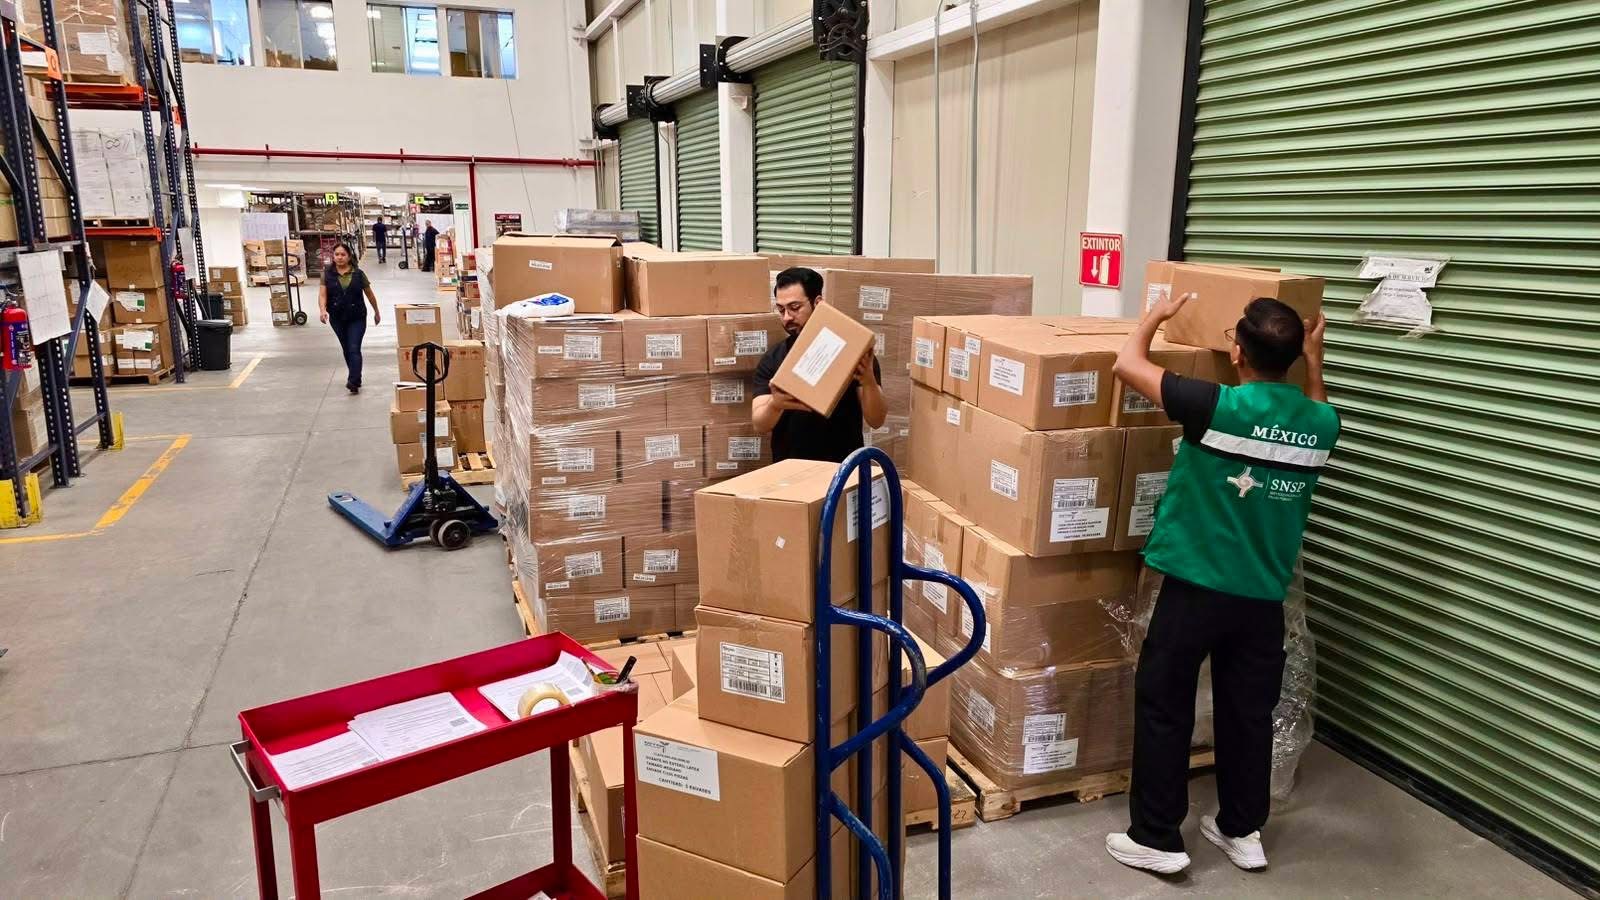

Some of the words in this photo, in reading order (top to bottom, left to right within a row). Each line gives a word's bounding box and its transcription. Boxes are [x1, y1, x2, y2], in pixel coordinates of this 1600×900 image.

[1082, 237, 1121, 251] EXTINTOR
[1251, 424, 1317, 446] MÉXICO
[1270, 479, 1306, 493] SNSP
[689, 786, 711, 794] ENVASES
